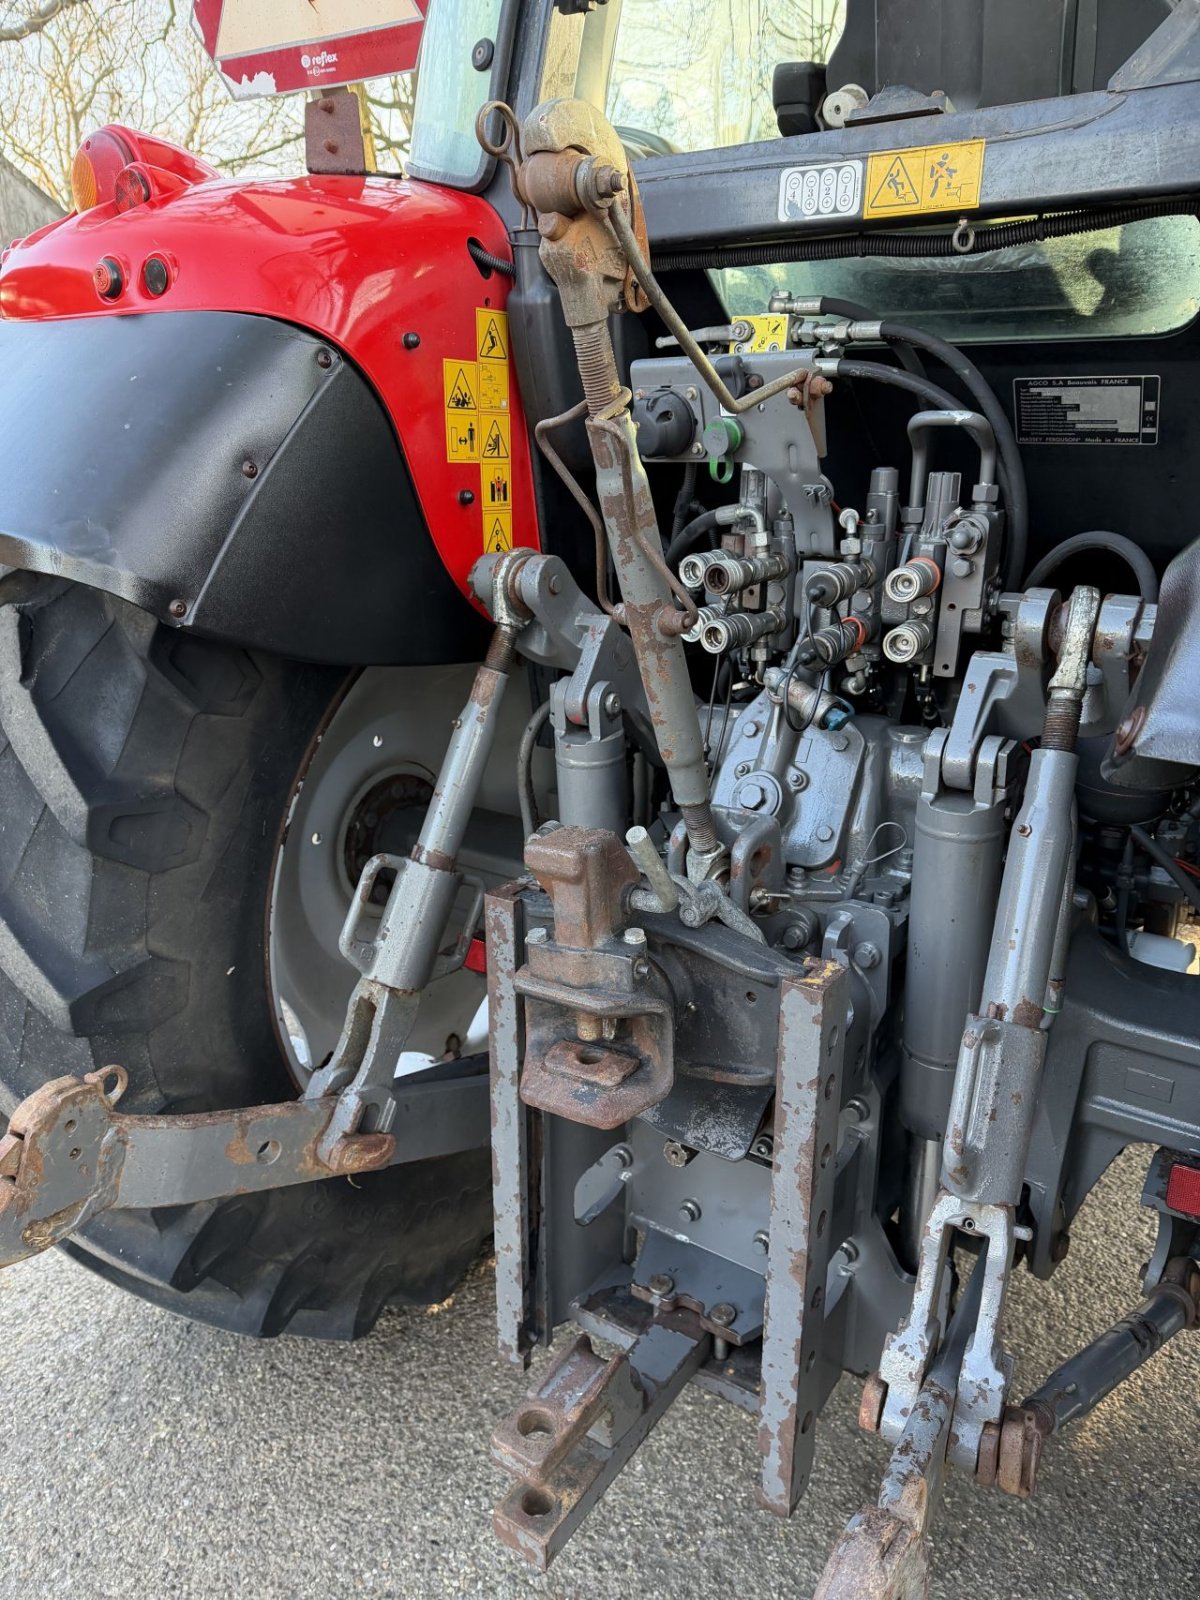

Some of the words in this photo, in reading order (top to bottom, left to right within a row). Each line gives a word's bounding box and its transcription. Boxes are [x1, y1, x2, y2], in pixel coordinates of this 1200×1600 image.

[312, 51, 338, 67] reflex
[790, 190, 796, 200] 4
[807, 188, 814, 198] 3
[824, 187, 831, 196] 2
[843, 185, 848, 194] 1
